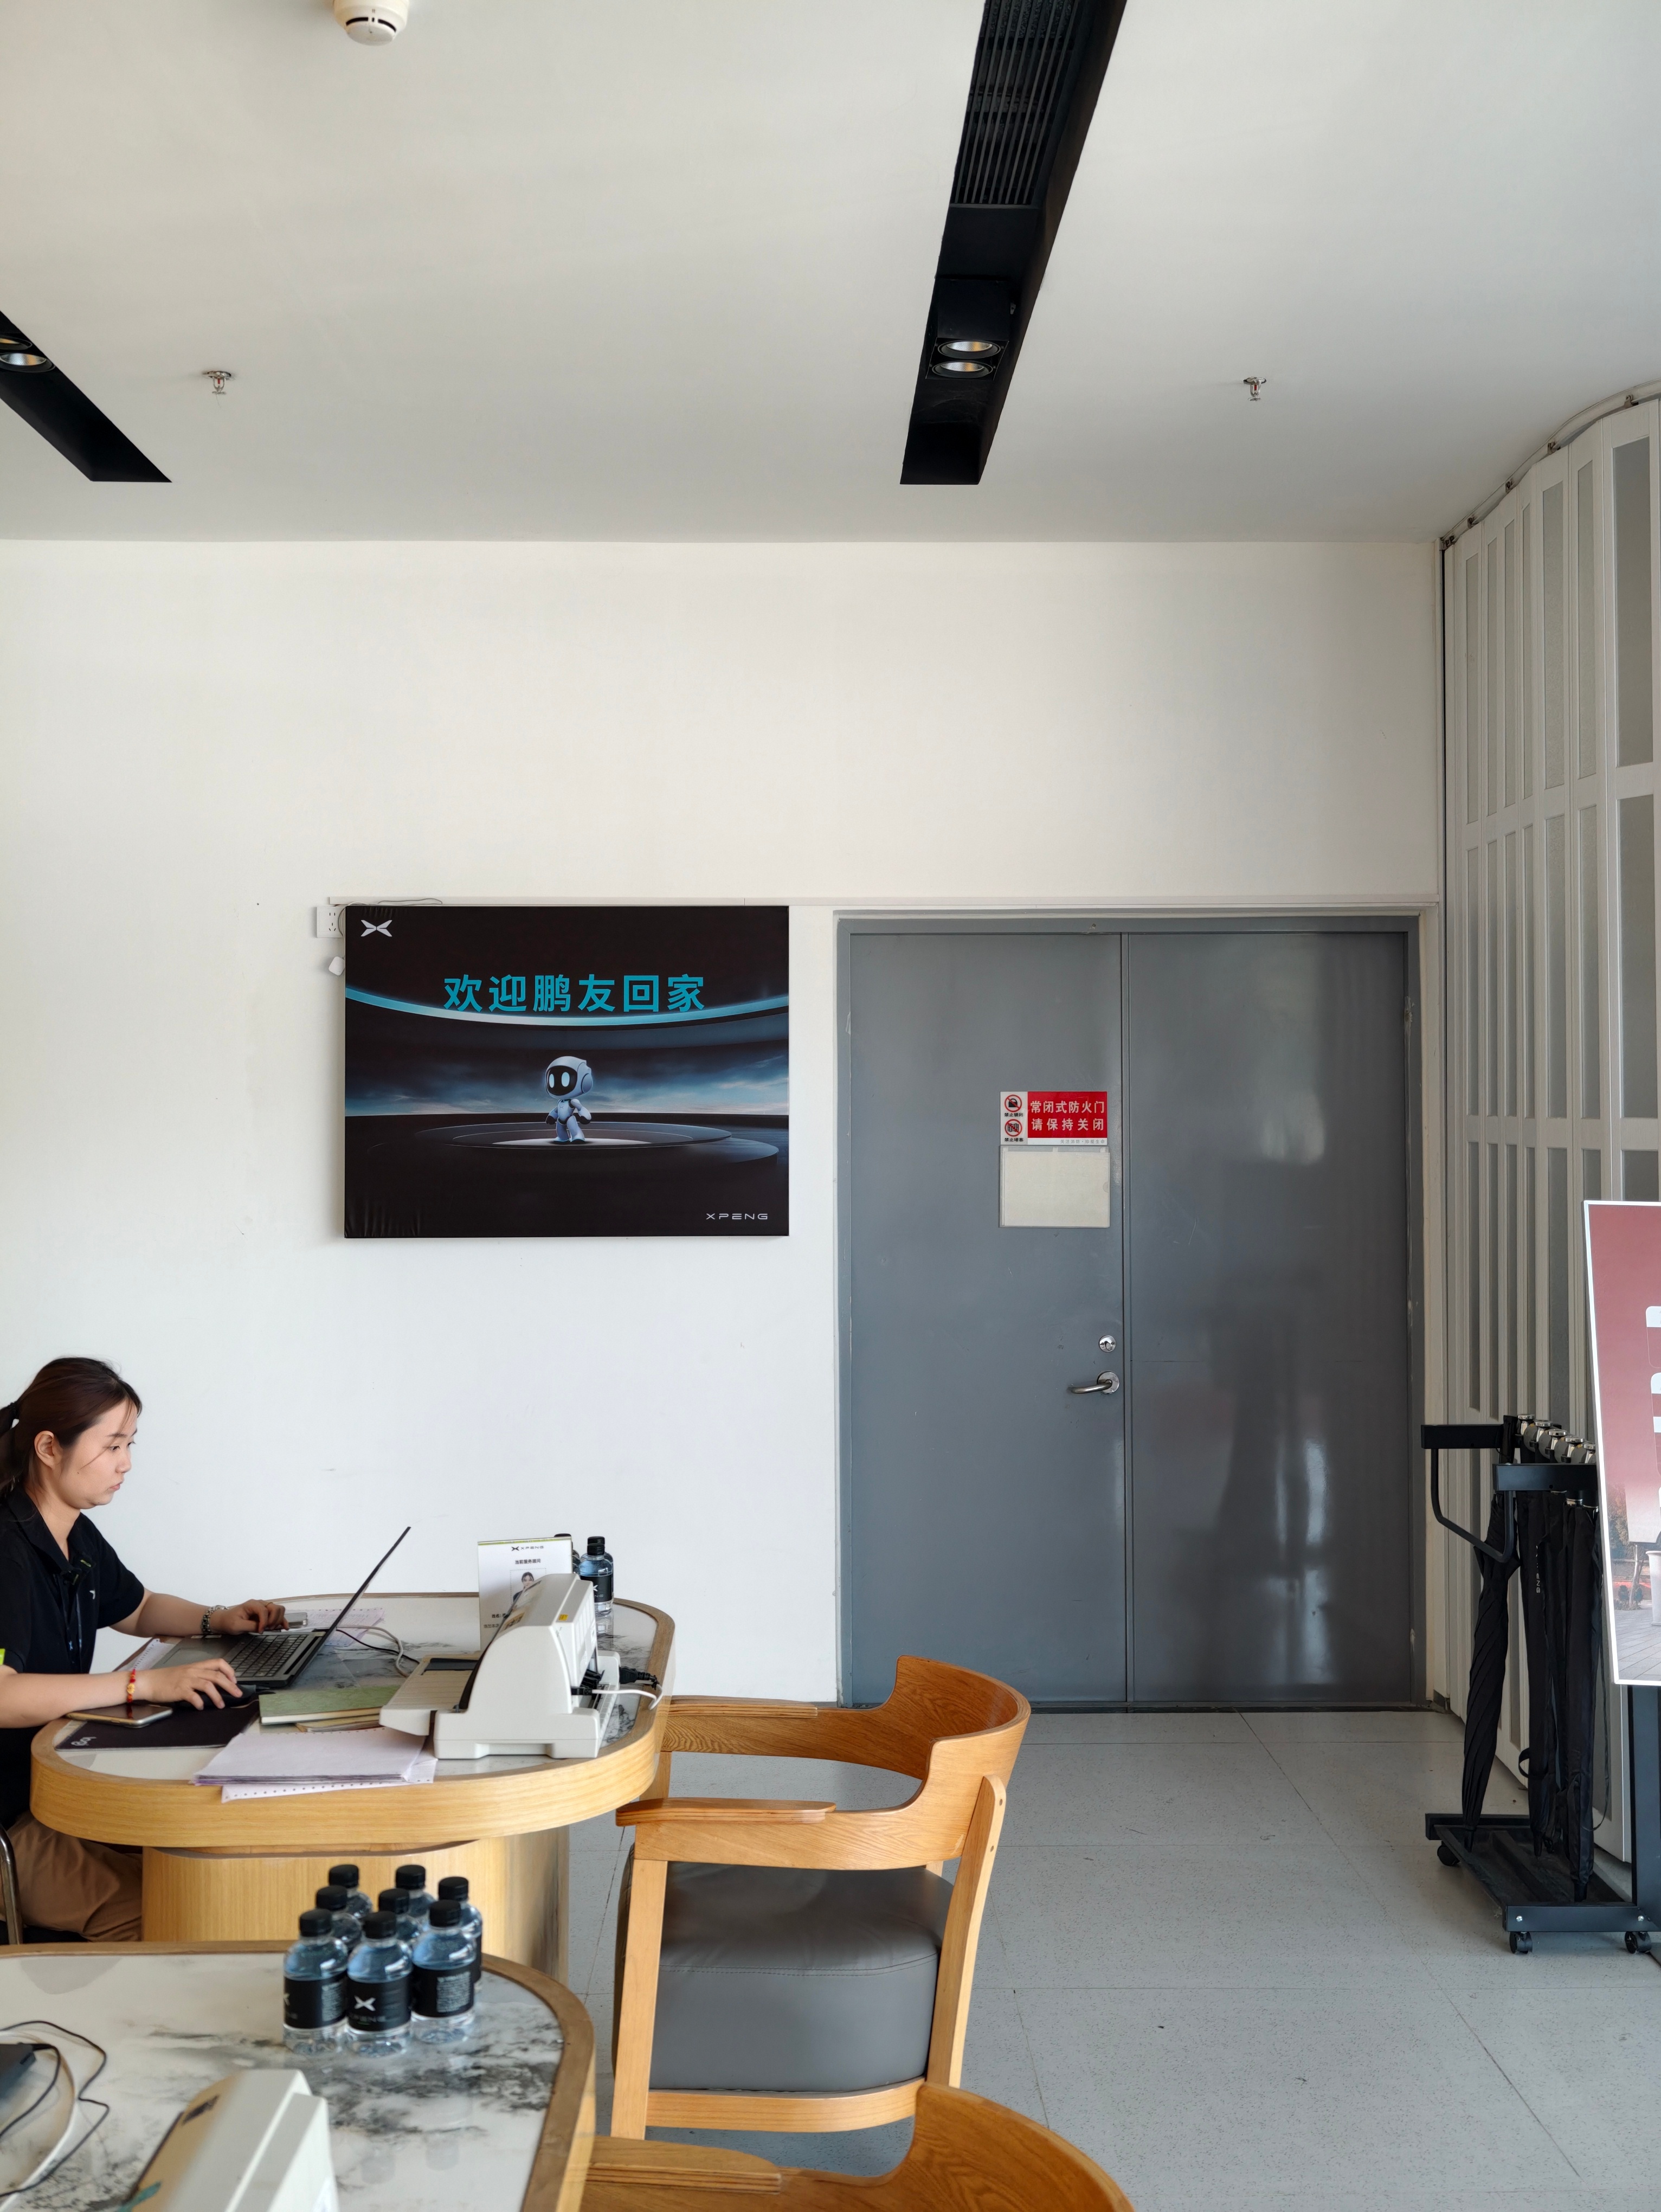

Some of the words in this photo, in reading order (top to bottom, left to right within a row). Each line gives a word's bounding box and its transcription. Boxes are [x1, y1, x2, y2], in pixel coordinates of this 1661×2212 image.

[443, 974, 705, 1012] 欢迎鹏友回家
[1030, 1101, 1104, 1114] 常闭式防火门
[1031, 1118, 1104, 1131] 请保持关闭
